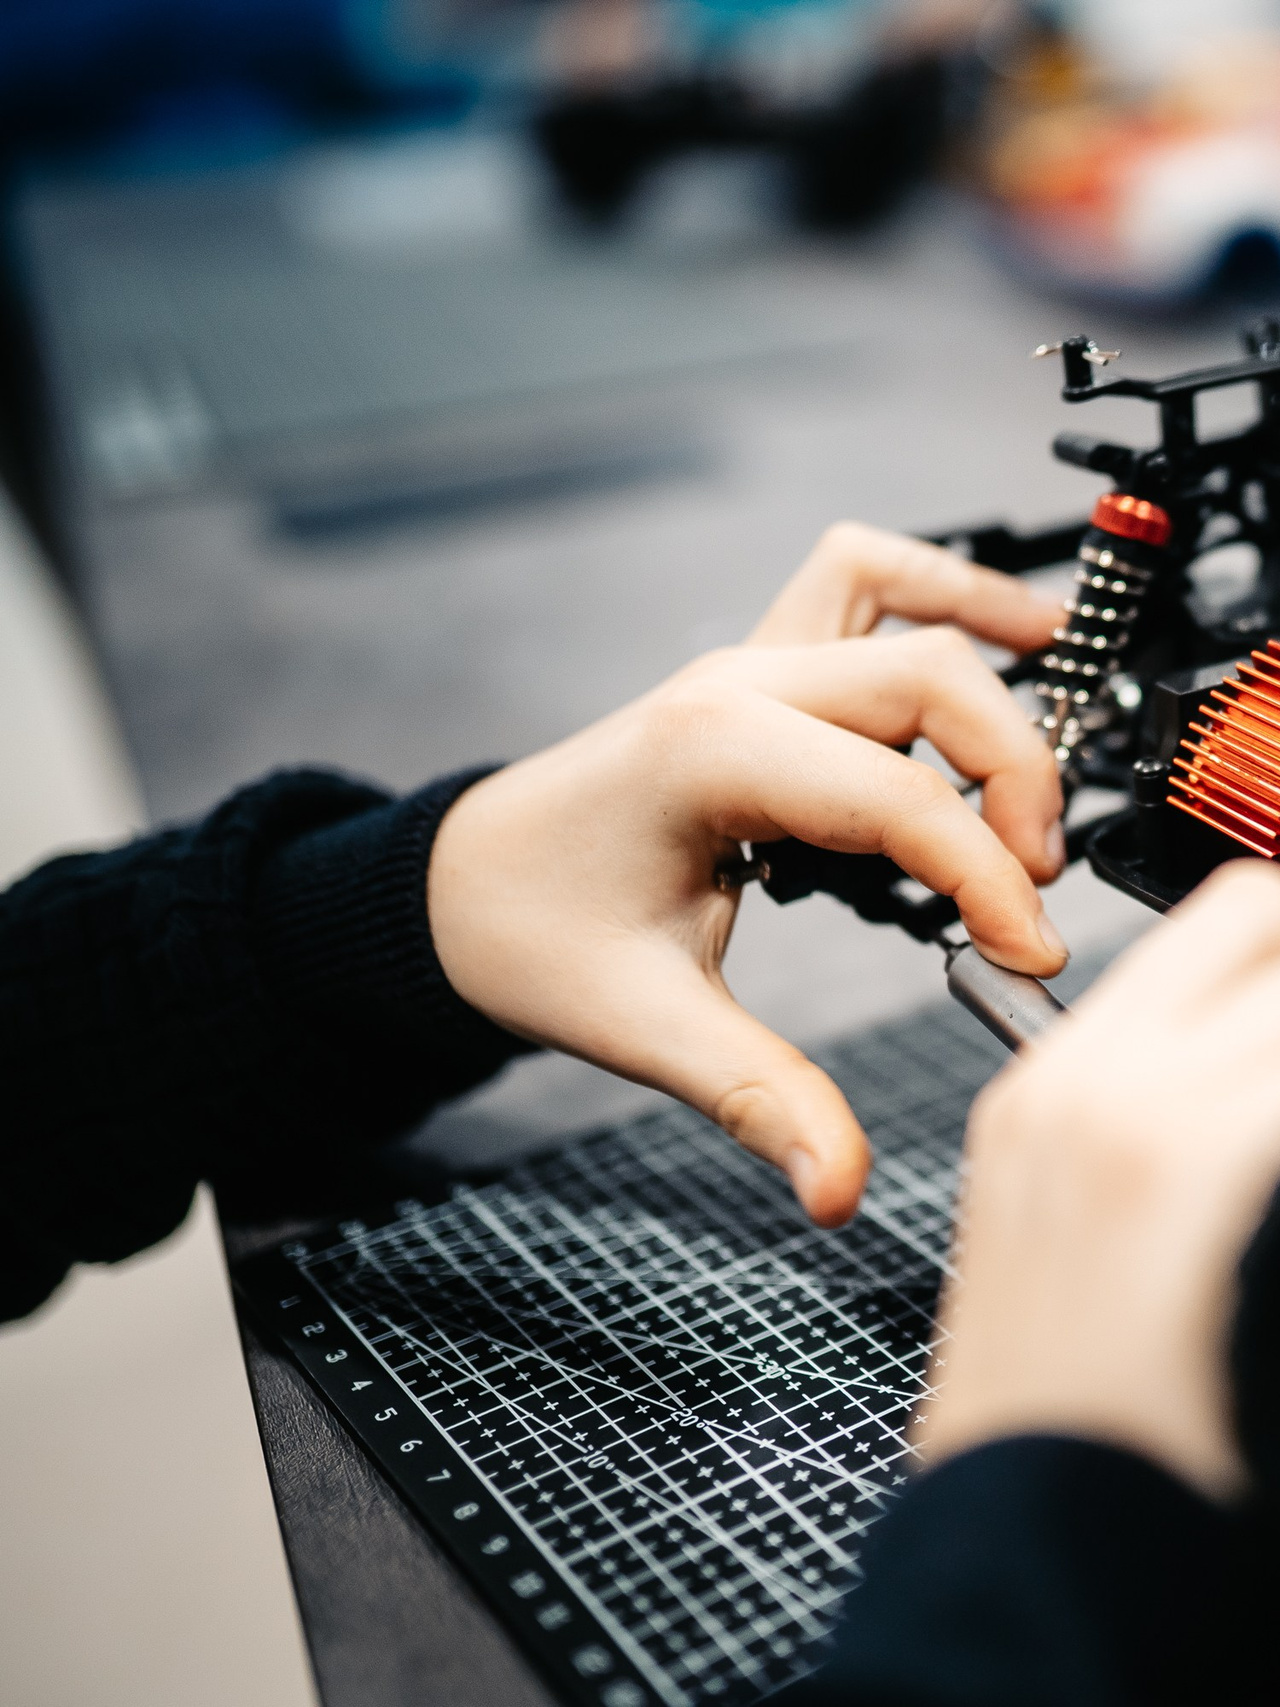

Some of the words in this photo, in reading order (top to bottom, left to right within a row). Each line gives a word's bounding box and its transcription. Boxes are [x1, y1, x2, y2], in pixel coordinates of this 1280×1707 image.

[302, 1321, 326, 1338] 2
[325, 1349, 348, 1364] 3
[351, 1379, 374, 1392] 4
[374, 1406, 398, 1422] 5
[399, 1439, 423, 1453] 6
[426, 1468, 452, 1482] 7
